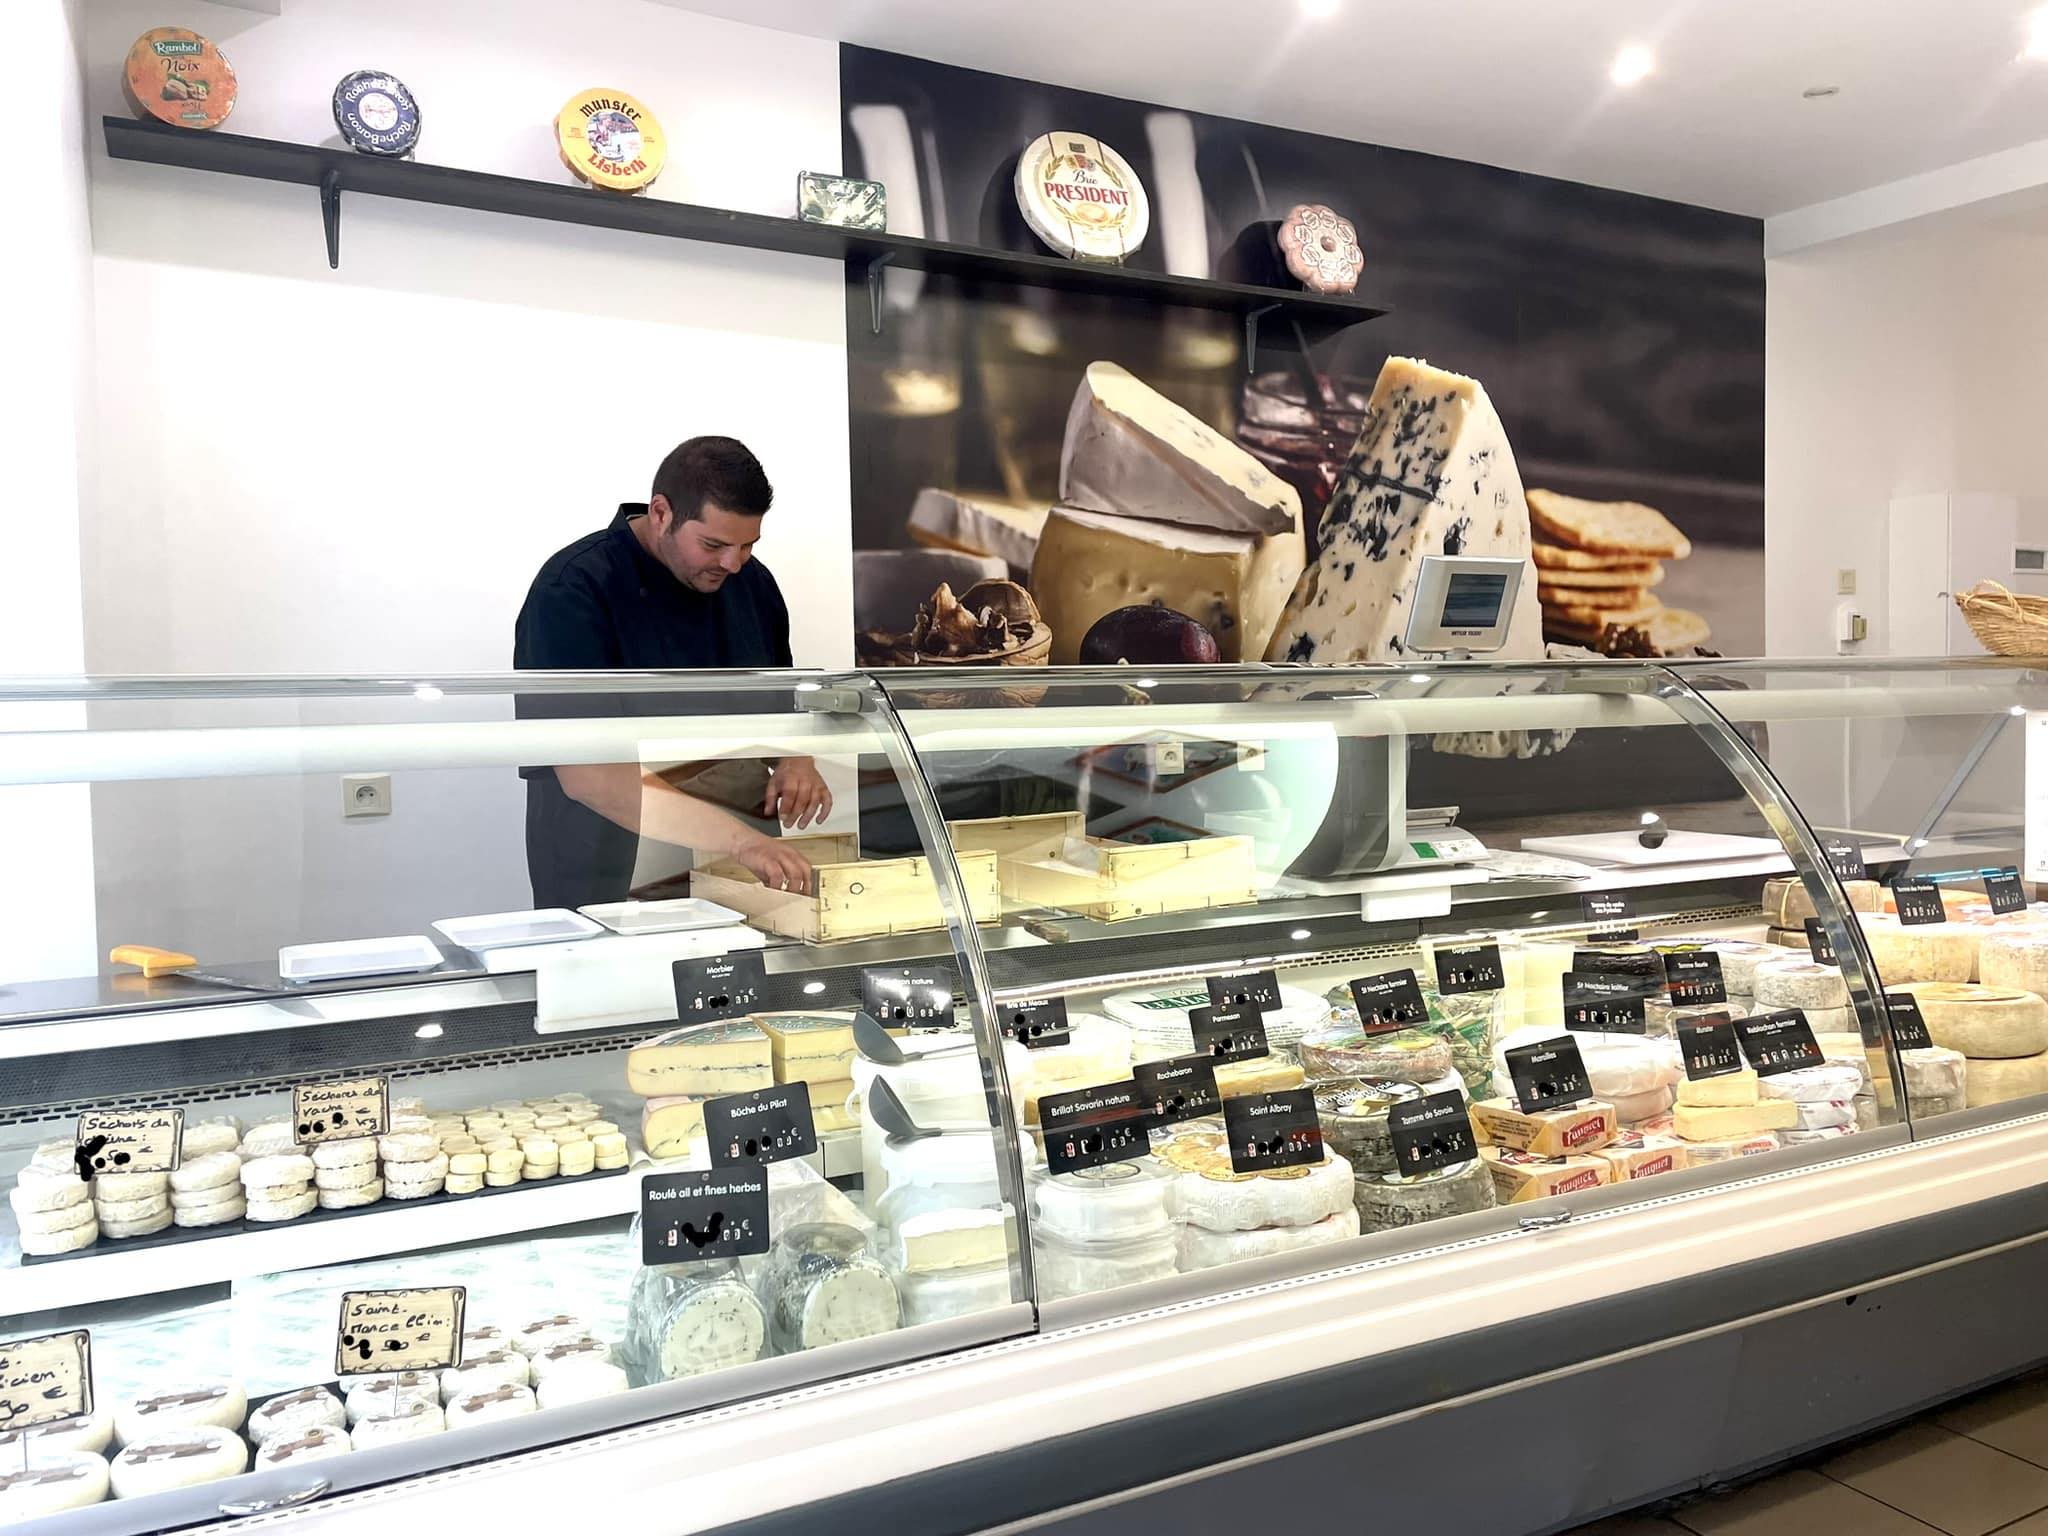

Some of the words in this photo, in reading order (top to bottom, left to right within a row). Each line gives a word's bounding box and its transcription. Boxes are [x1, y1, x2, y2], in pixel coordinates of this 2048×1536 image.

[154, 41, 198, 55] Rambol
[160, 57, 200, 72] Noix
[587, 153, 648, 176] Lisbeth
[1073, 169, 1098, 184] Brie
[1044, 182, 1128, 206] PRESIDENT
[706, 964, 735, 975] Morbier
[1156, 1067, 1193, 1080] Rochebaron
[730, 1105, 757, 1118] Bûche
[758, 1103, 769, 1112] du
[770, 1098, 787, 1109] Pilat
[1051, 1105, 1074, 1117] Brillat
[1075, 1099, 1104, 1112] Savarin
[1104, 1094, 1130, 1107] nature
[1249, 1105, 1268, 1116] Saint
[1269, 1104, 1292, 1115] Albray
[1401, 1114, 1424, 1126] Tomme
[1424, 1111, 1434, 1121] de
[1433, 1106, 1455, 1118] Savoie
[648, 1188, 677, 1200] Roulé
[678, 1187, 691, 1198] ail
[693, 1186, 703, 1197] et
[704, 1185, 728, 1195] fines
[729, 1182, 761, 1193] herbes
